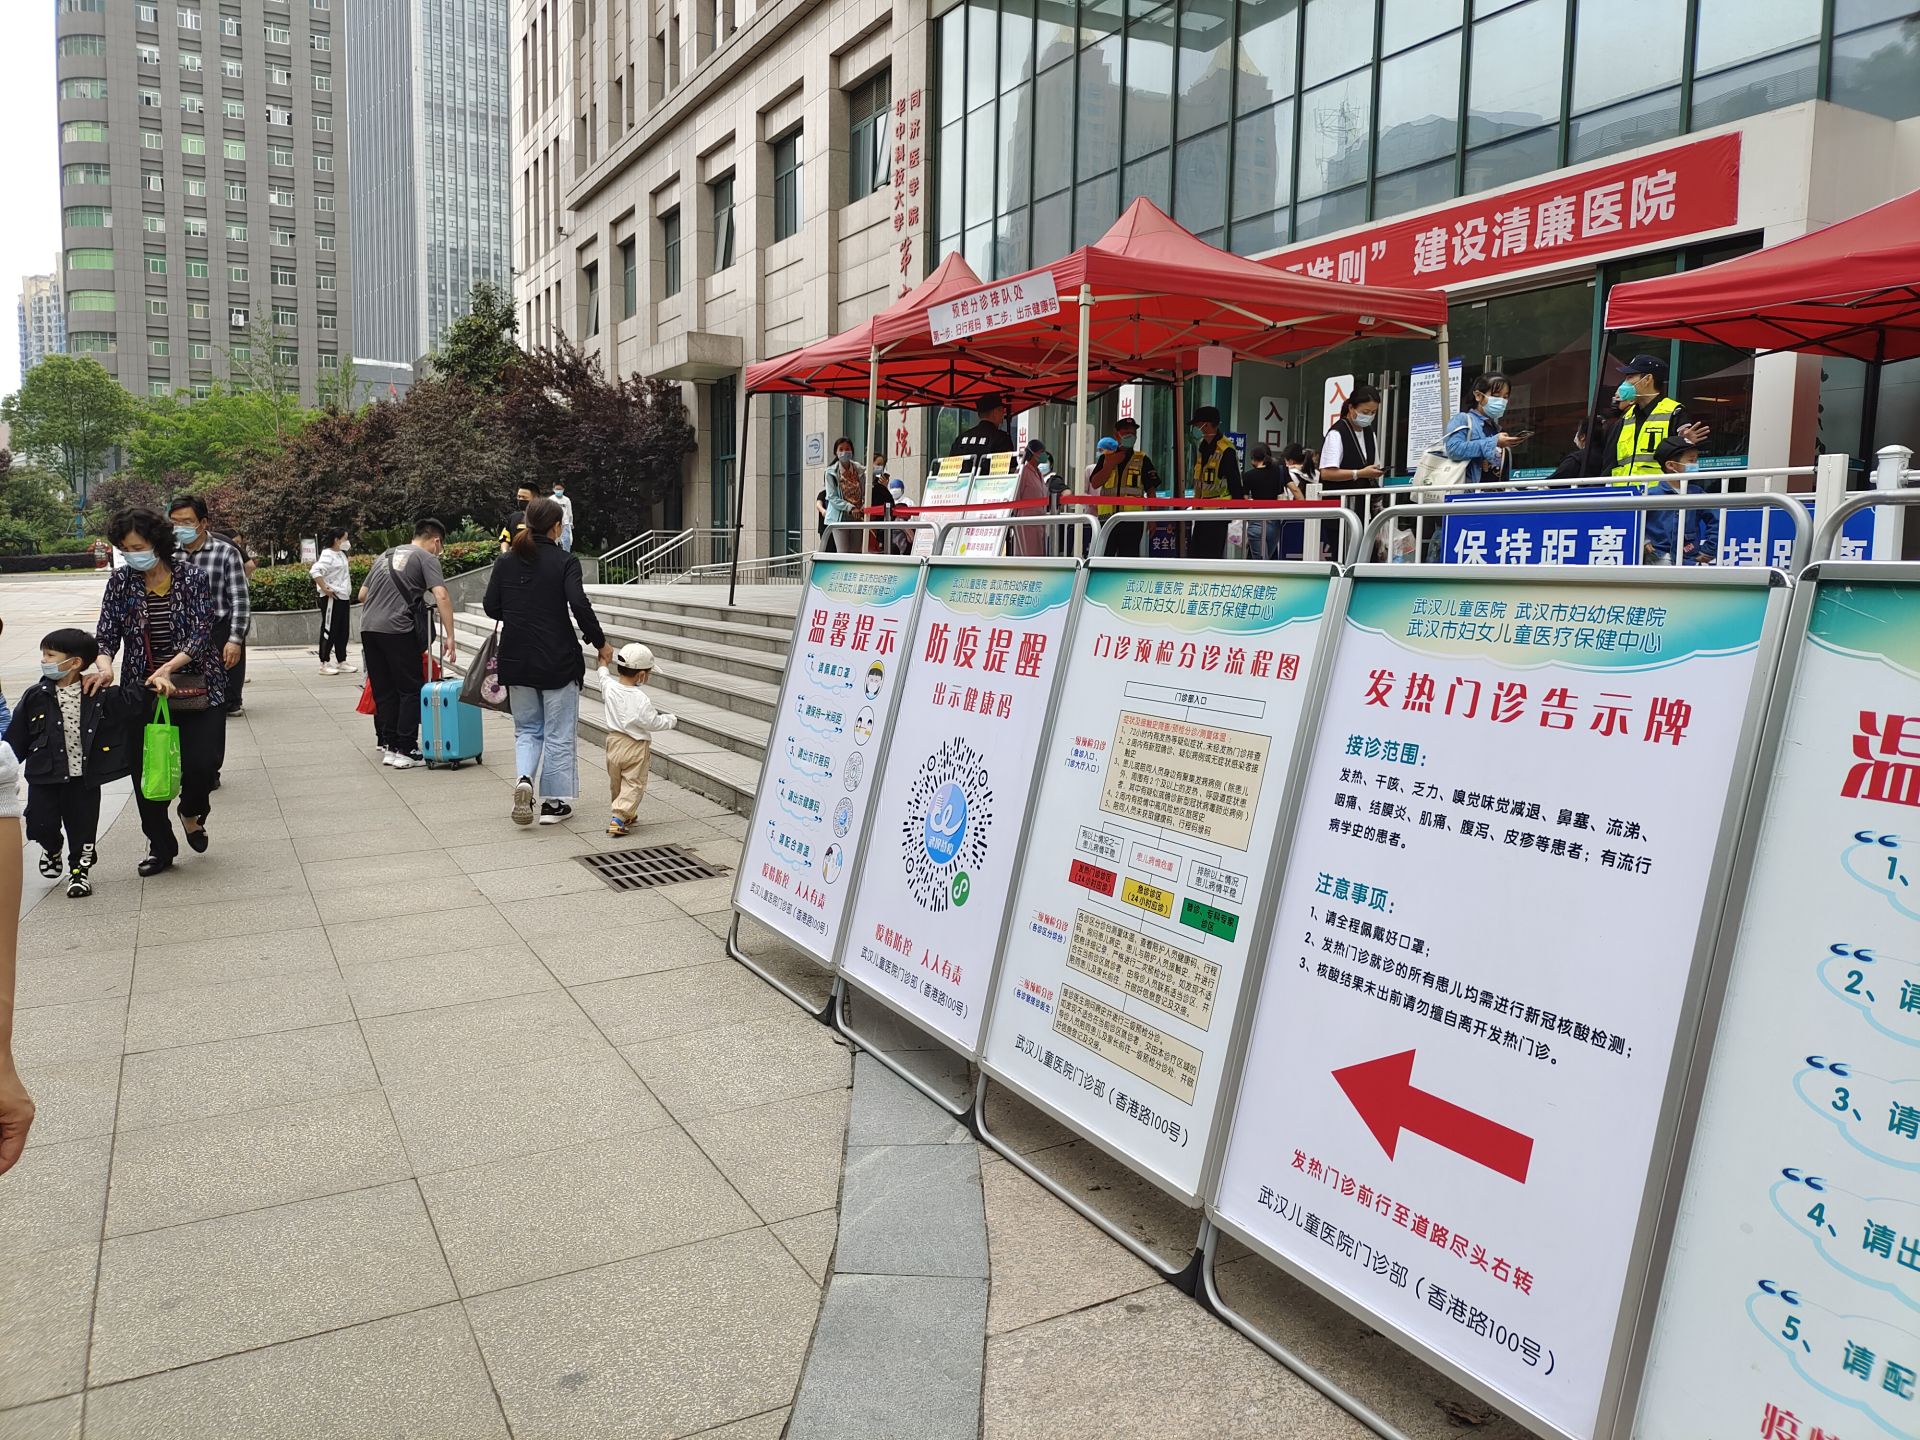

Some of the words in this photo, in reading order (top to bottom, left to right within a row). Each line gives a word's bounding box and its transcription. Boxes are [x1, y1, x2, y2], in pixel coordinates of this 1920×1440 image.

[893, 97, 906, 232] 华中科技大学
[908, 89, 921, 227] 同济医学院
[1284, 238, 1387, 286] 准则”
[1412, 167, 1678, 277] 建设清廉医院
[951, 284, 1024, 319] 预检分诊排队处
[1265, 401, 1283, 447] 入口
[1454, 526, 1627, 565] 保持距离
[1120, 596, 1274, 621] 武汉市妇女儿童医疗保健中心
[1126, 579, 1185, 596] 武汉儿童医院
[1188, 582, 1278, 601] 武汉市妇幼保健院
[1412, 598, 1507, 620] 武汉儿童医院
[1514, 601, 1668, 628] 武汉市妇幼保健院
[807, 609, 899, 655] 温馨提示
[924, 622, 1047, 678] 防疫提醒
[1405, 618, 1662, 654] 武汉市妇女儿童医疗保健中心
[1093, 633, 1301, 681] 门诊预检分诊流程图
[932, 681, 1013, 720] 出示健康码
[1174, 692, 1207, 705] 门诊部入口
[1363, 668, 1693, 747] 发热门诊告示牌
[1345, 733, 1428, 767] 接诊范围：
[1338, 766, 1650, 844] 发热、干咳、乏力、嗅觉味觉减退、鼻塞、流涕、
[1328, 817, 1409, 851] 病学史的患者。
[1333, 791, 1653, 877] 咽痛、结膜炎、肌痛、腹泻、皮疹等患者；有流行
[761, 862, 790, 890] 疫情防控
[795, 881, 827, 910] 人人有责
[1137, 884, 1162, 900] 急诊诊区
[1314, 871, 1396, 914] 注意事项：
[1200, 919, 1215, 932] 诊区
[1309, 906, 1431, 957] 1、请全程佩戴好口罩；
[874, 923, 913, 957] 疫情防控
[920, 949, 963, 986] 人人有责
[860, 945, 969, 1020] 武汉儿童医院门诊部（香港路100号）
[1303, 931, 1633, 1059] 2、发热门诊就诊的所有患儿均需进行新冠核酸检测；
[1298, 956, 1558, 1066] 3、核酸结果未出前请勿擅自离开发热门诊。
[1015, 1033, 1189, 1148] 武汉儿童医院门诊部（香港路100号）
[1291, 1148, 1535, 1296] 发热门诊前行至道路尽头右转
[1257, 1185, 1556, 1376] 武汉儿童医院门诊部（香港路100号）
